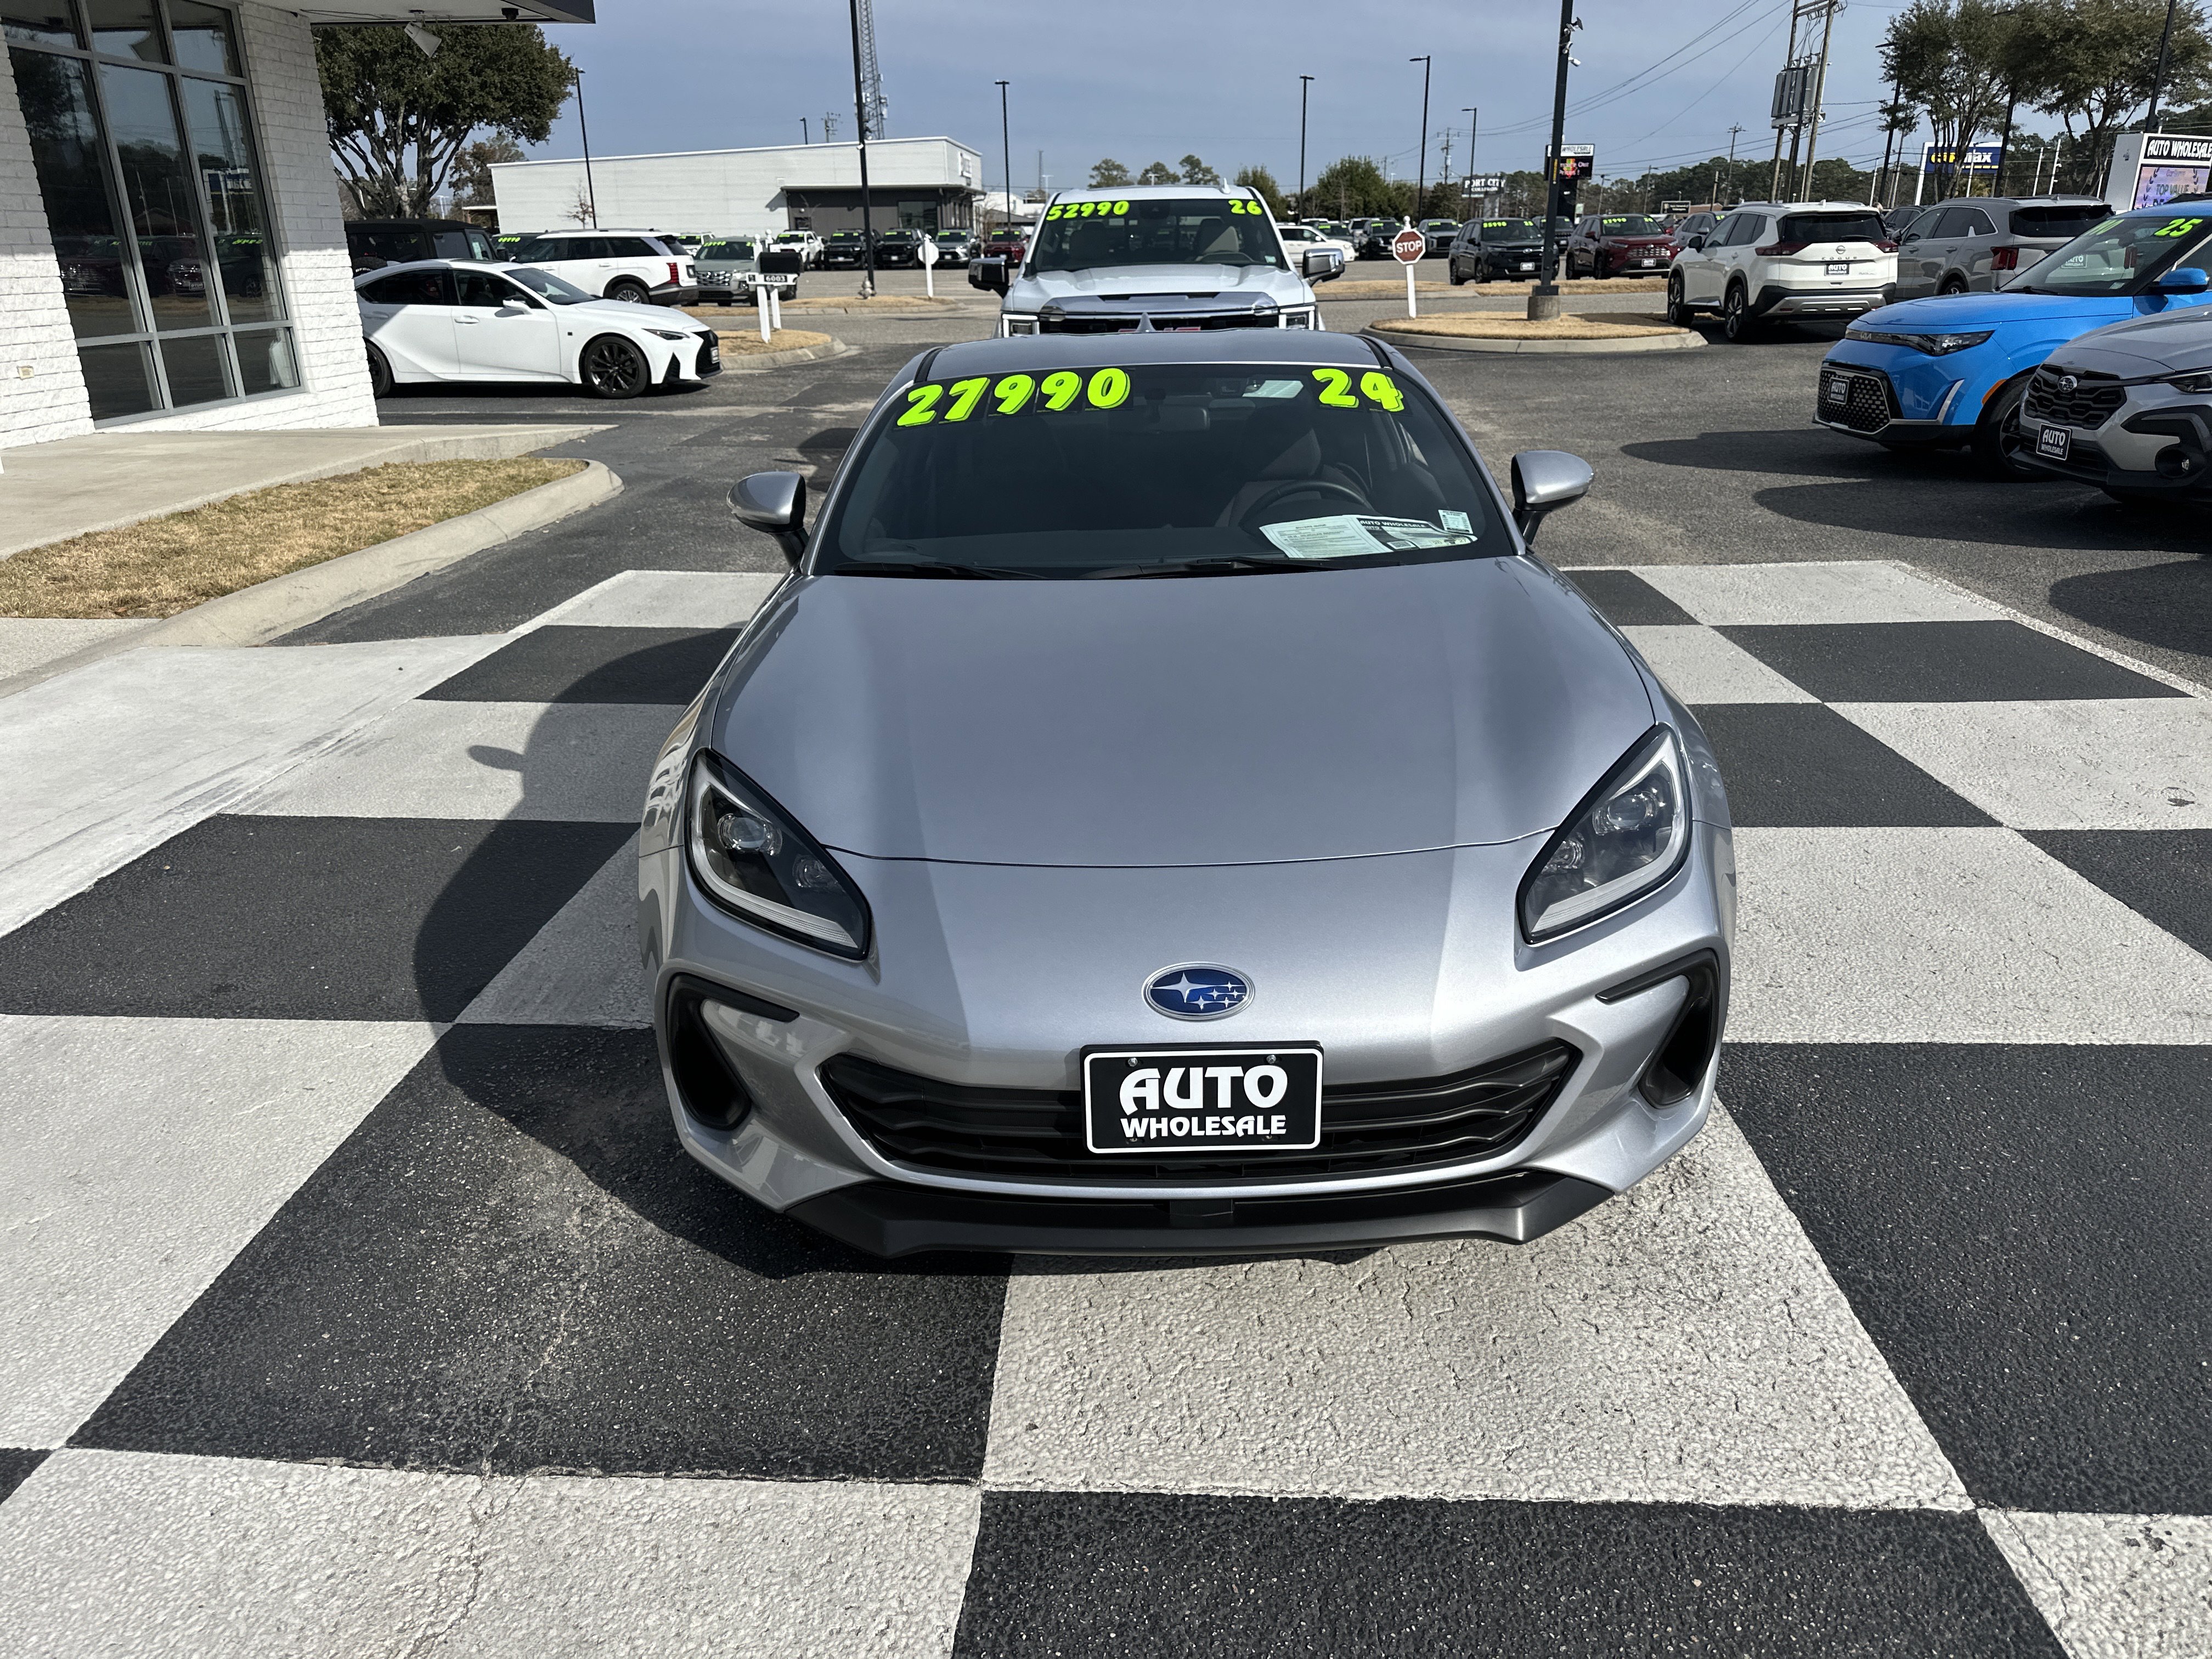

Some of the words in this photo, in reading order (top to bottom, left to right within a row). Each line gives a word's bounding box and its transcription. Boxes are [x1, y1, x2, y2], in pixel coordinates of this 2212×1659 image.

[2147, 139, 2170, 156] AUTO
[2171, 140, 2212, 159] WHOLESALE
[1464, 178, 1486, 188] PORT
[1487, 178, 1506, 188] CITY
[1046, 200, 1130, 221] 52990
[1228, 199, 1263, 215] 26
[2153, 218, 2204, 237] 25
[1396, 240, 1422, 253] STOP
[897, 367, 1131, 427] 27990
[1312, 368, 1404, 411] 24
[2042, 429, 2066, 446] AUTO
[2041, 444, 2063, 455] WHOLESALE
[1120, 1065, 1288, 1116] AUTO
[1120, 1115, 1287, 1139] WHOLESALE
